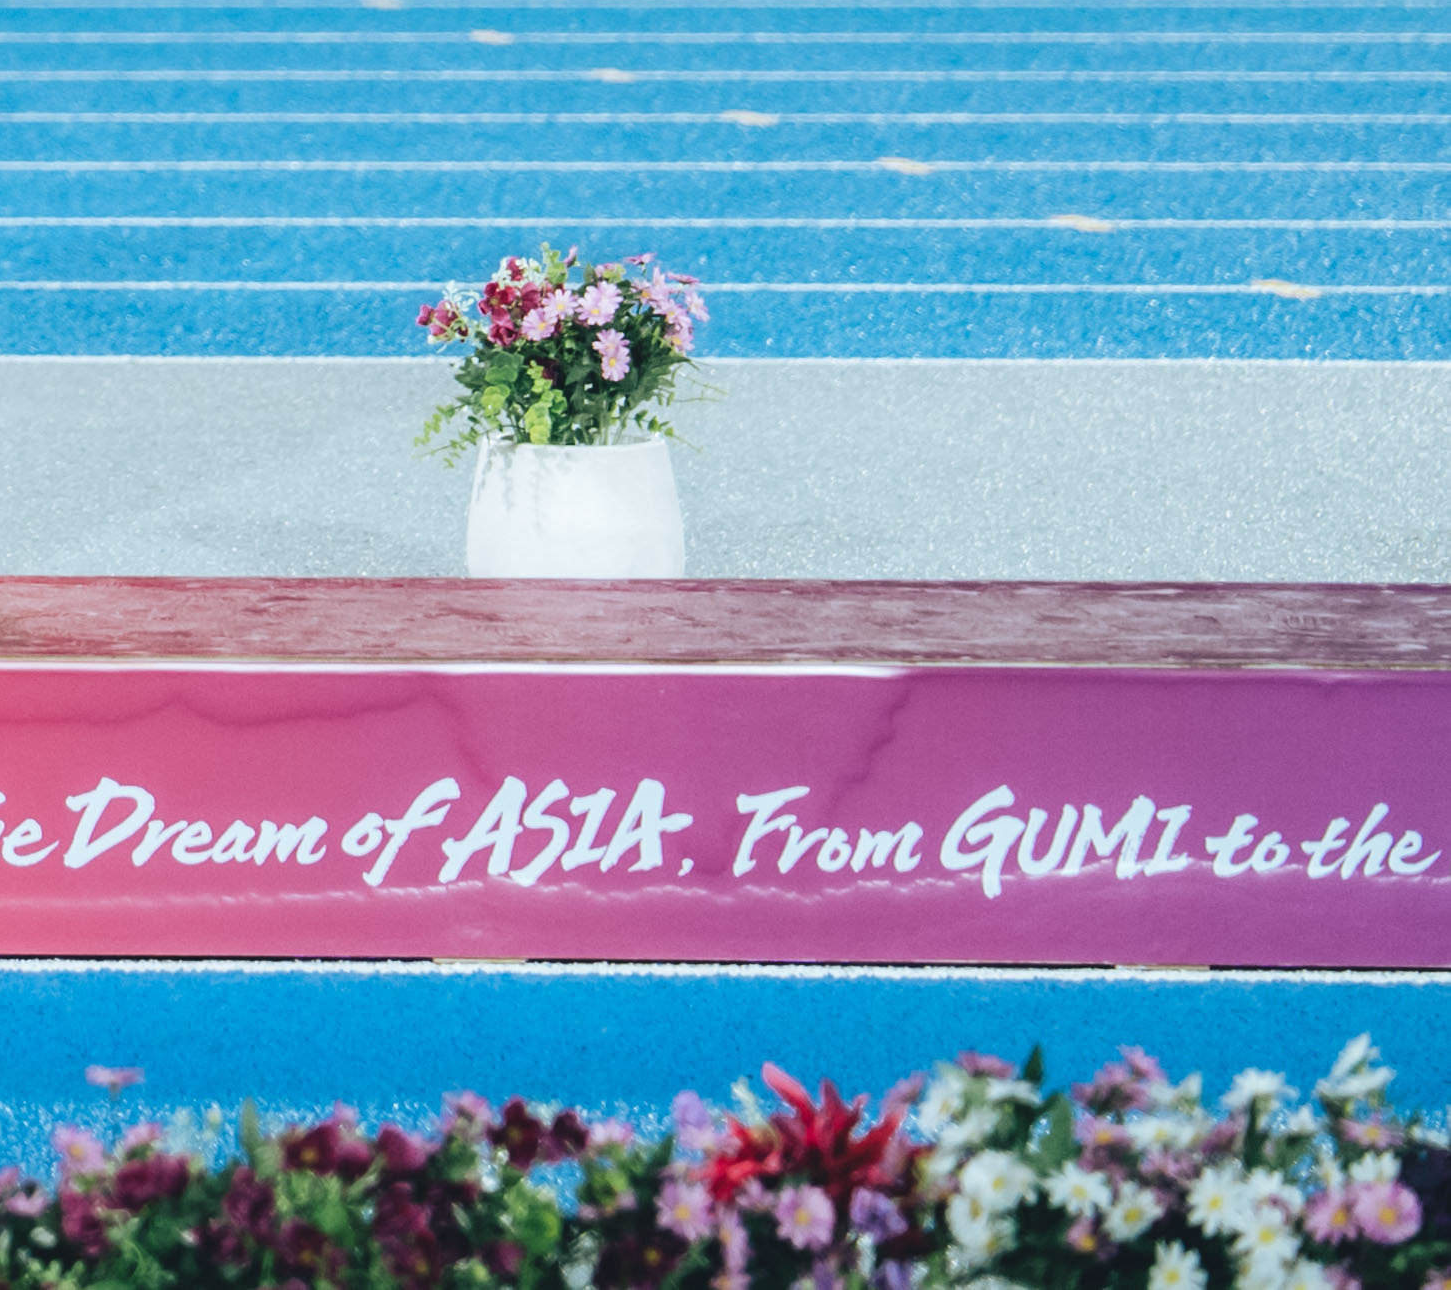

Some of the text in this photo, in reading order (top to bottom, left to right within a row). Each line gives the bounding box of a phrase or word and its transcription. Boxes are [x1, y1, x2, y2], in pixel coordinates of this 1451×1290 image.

[64, 776, 328, 874] Dream
[341, 776, 462, 887] of
[732, 785, 923, 879] From
[940, 784, 1192, 900] GUMI
[1205, 817, 1292, 880] to
[1300, 802, 1443, 881] the
